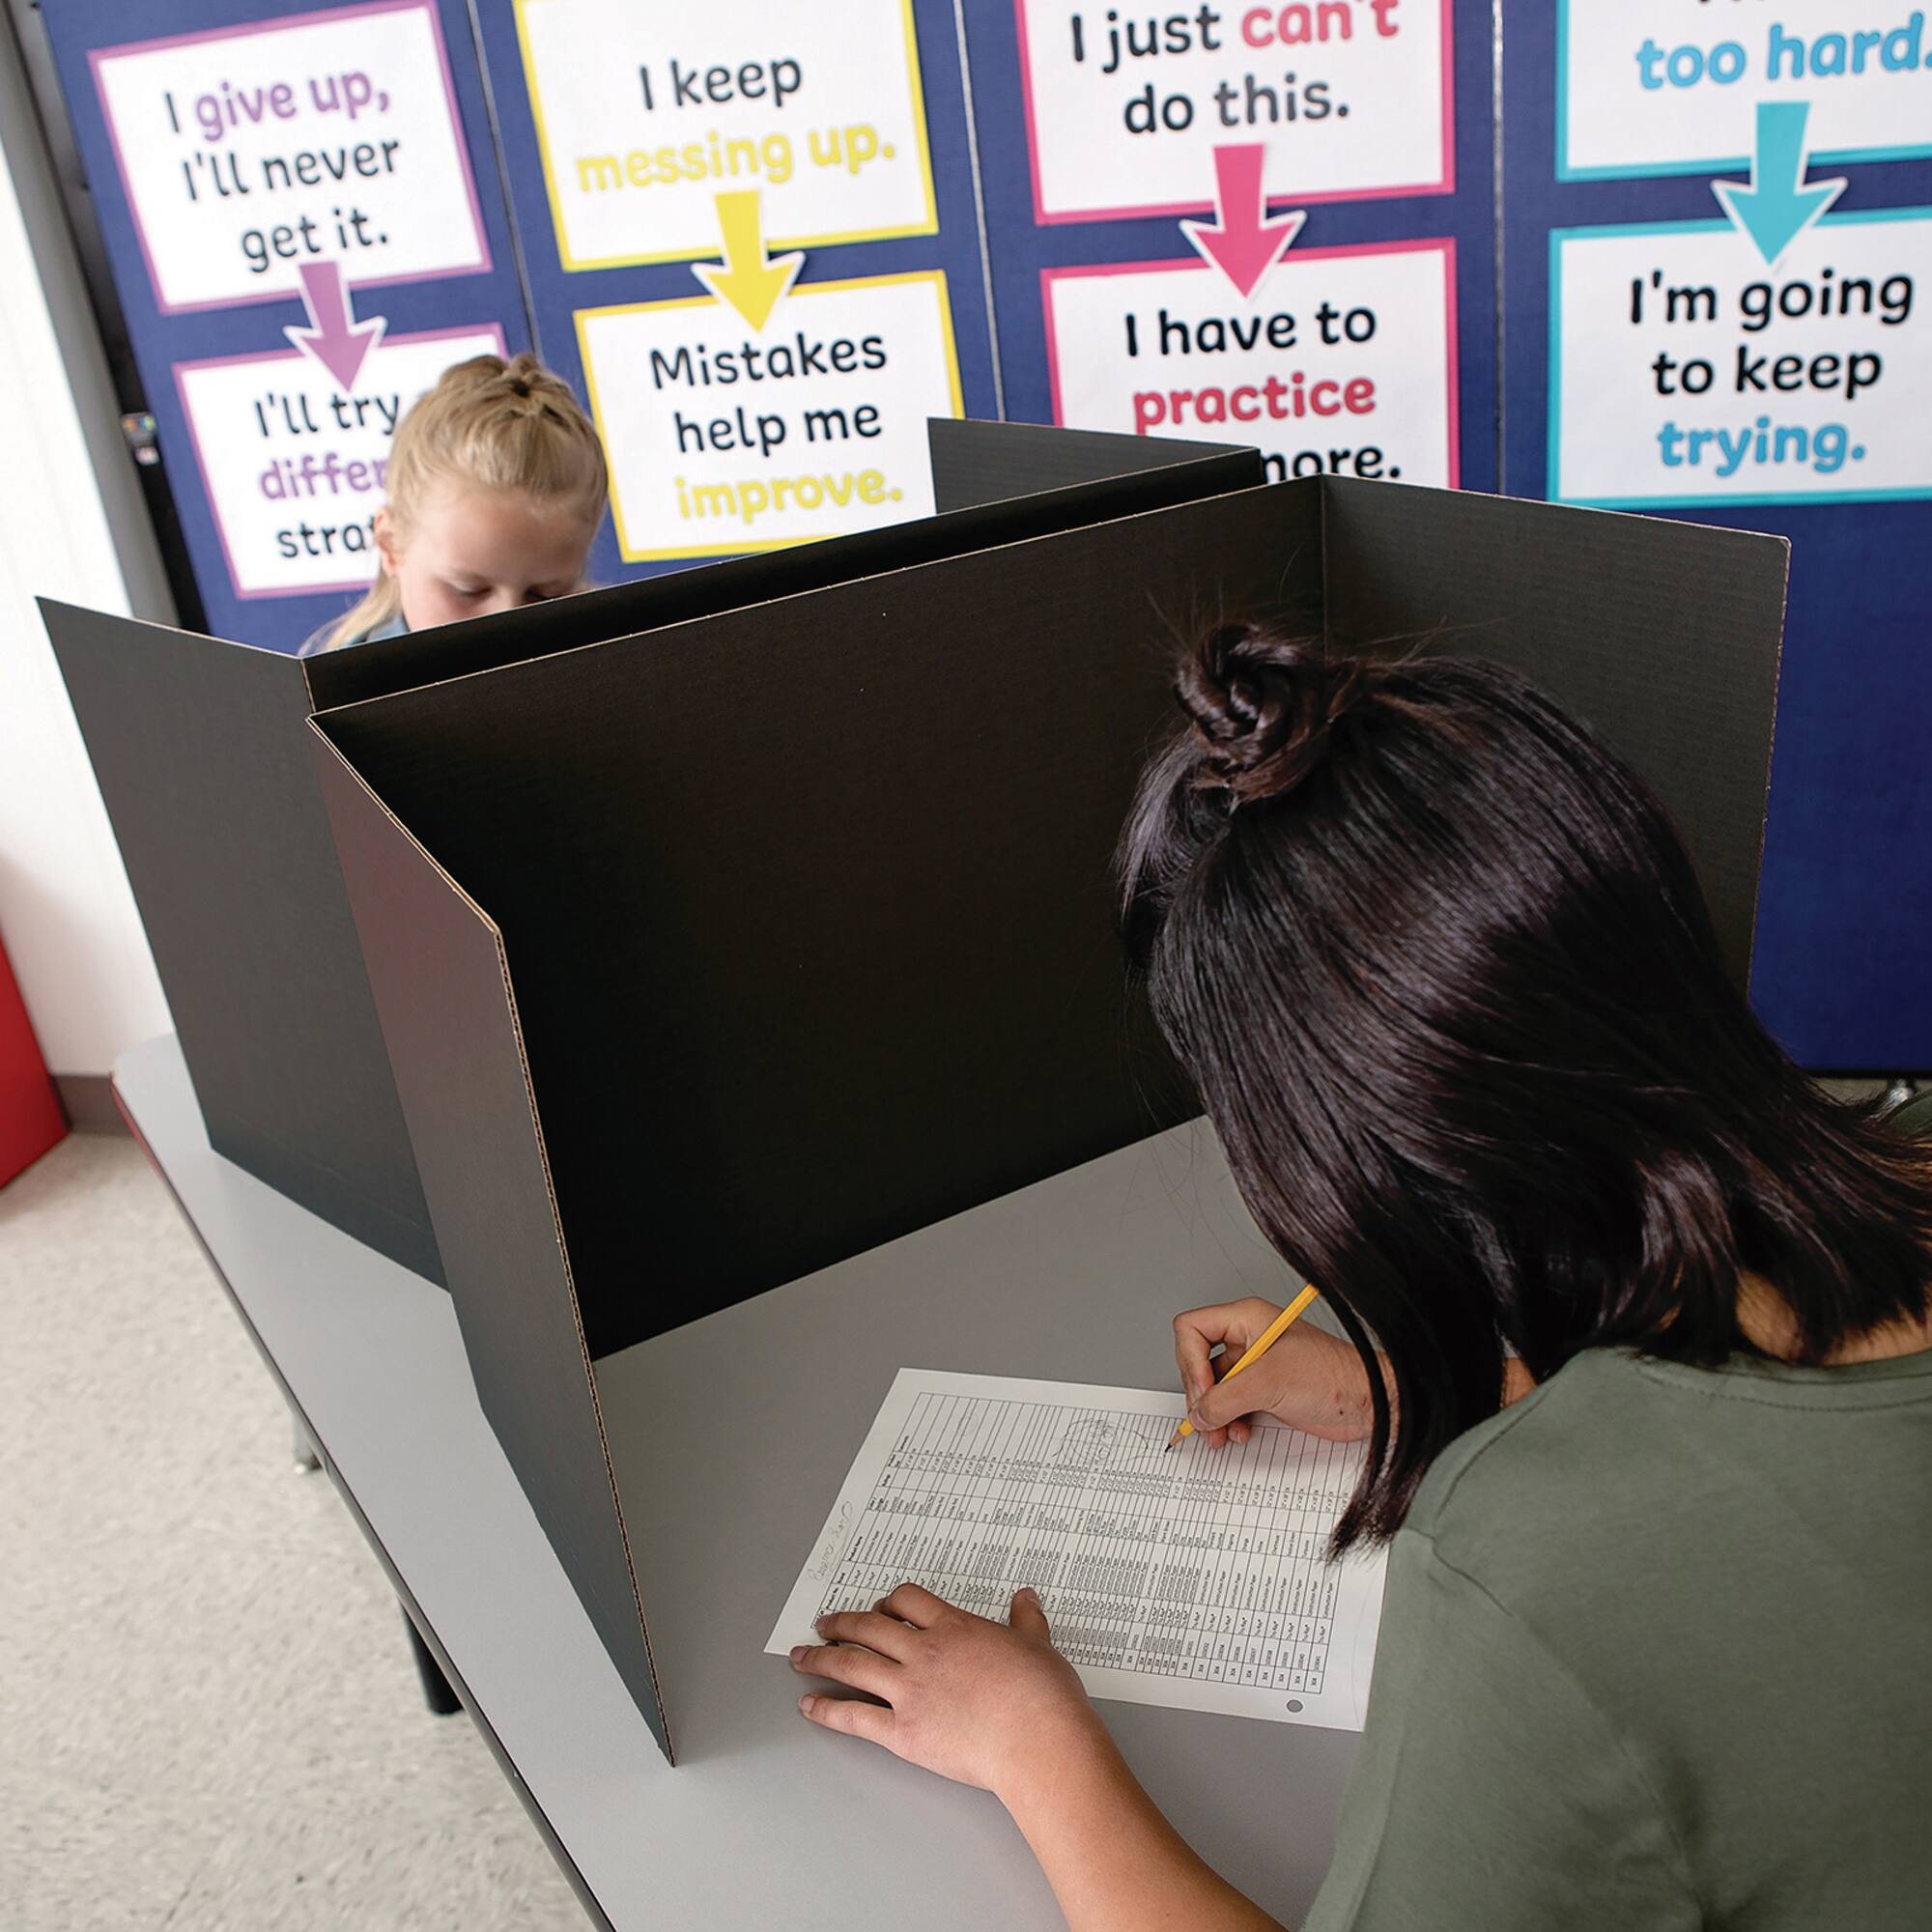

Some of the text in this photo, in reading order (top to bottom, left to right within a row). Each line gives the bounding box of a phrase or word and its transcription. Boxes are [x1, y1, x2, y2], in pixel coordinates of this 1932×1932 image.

[1071, 0, 1398, 74] I just cant
[1636, 11, 1932, 89] too hard.
[165, 73, 388, 141] I give up,
[639, 59, 802, 110] I keep
[1124, 72, 1349, 134] do this.
[184, 141, 399, 200] I'll never
[578, 126, 895, 191] messing up.
[242, 209, 386, 273] get it.
[1125, 301, 1377, 357] I have to
[1631, 268, 1914, 332] I'm going
[650, 331, 887, 389] Mistakes
[1652, 345, 1883, 401] to keep
[255, 393, 399, 437] I'll try
[674, 405, 882, 457] help me
[1133, 372, 1377, 436] practice
[1658, 416, 1865, 477] trying.
[676, 470, 902, 524] improve.
